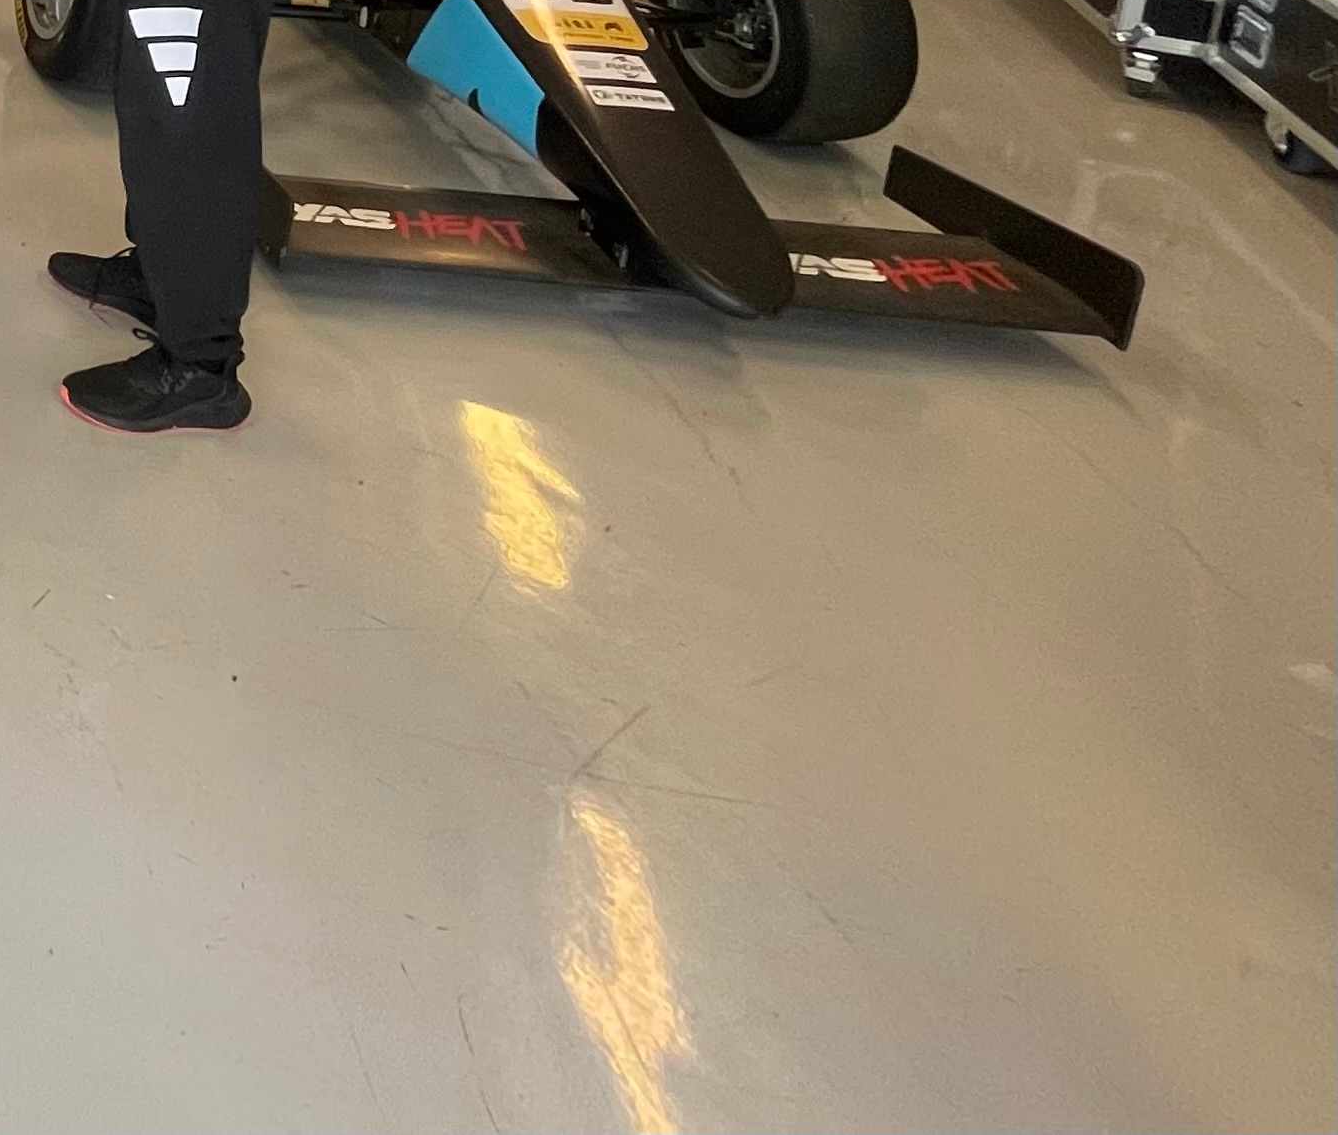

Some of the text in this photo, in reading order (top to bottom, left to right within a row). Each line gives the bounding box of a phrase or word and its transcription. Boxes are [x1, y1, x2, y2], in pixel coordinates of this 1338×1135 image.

[293, 203, 528, 252] YAS HEAT
[874, 255, 1021, 293] HEAT
